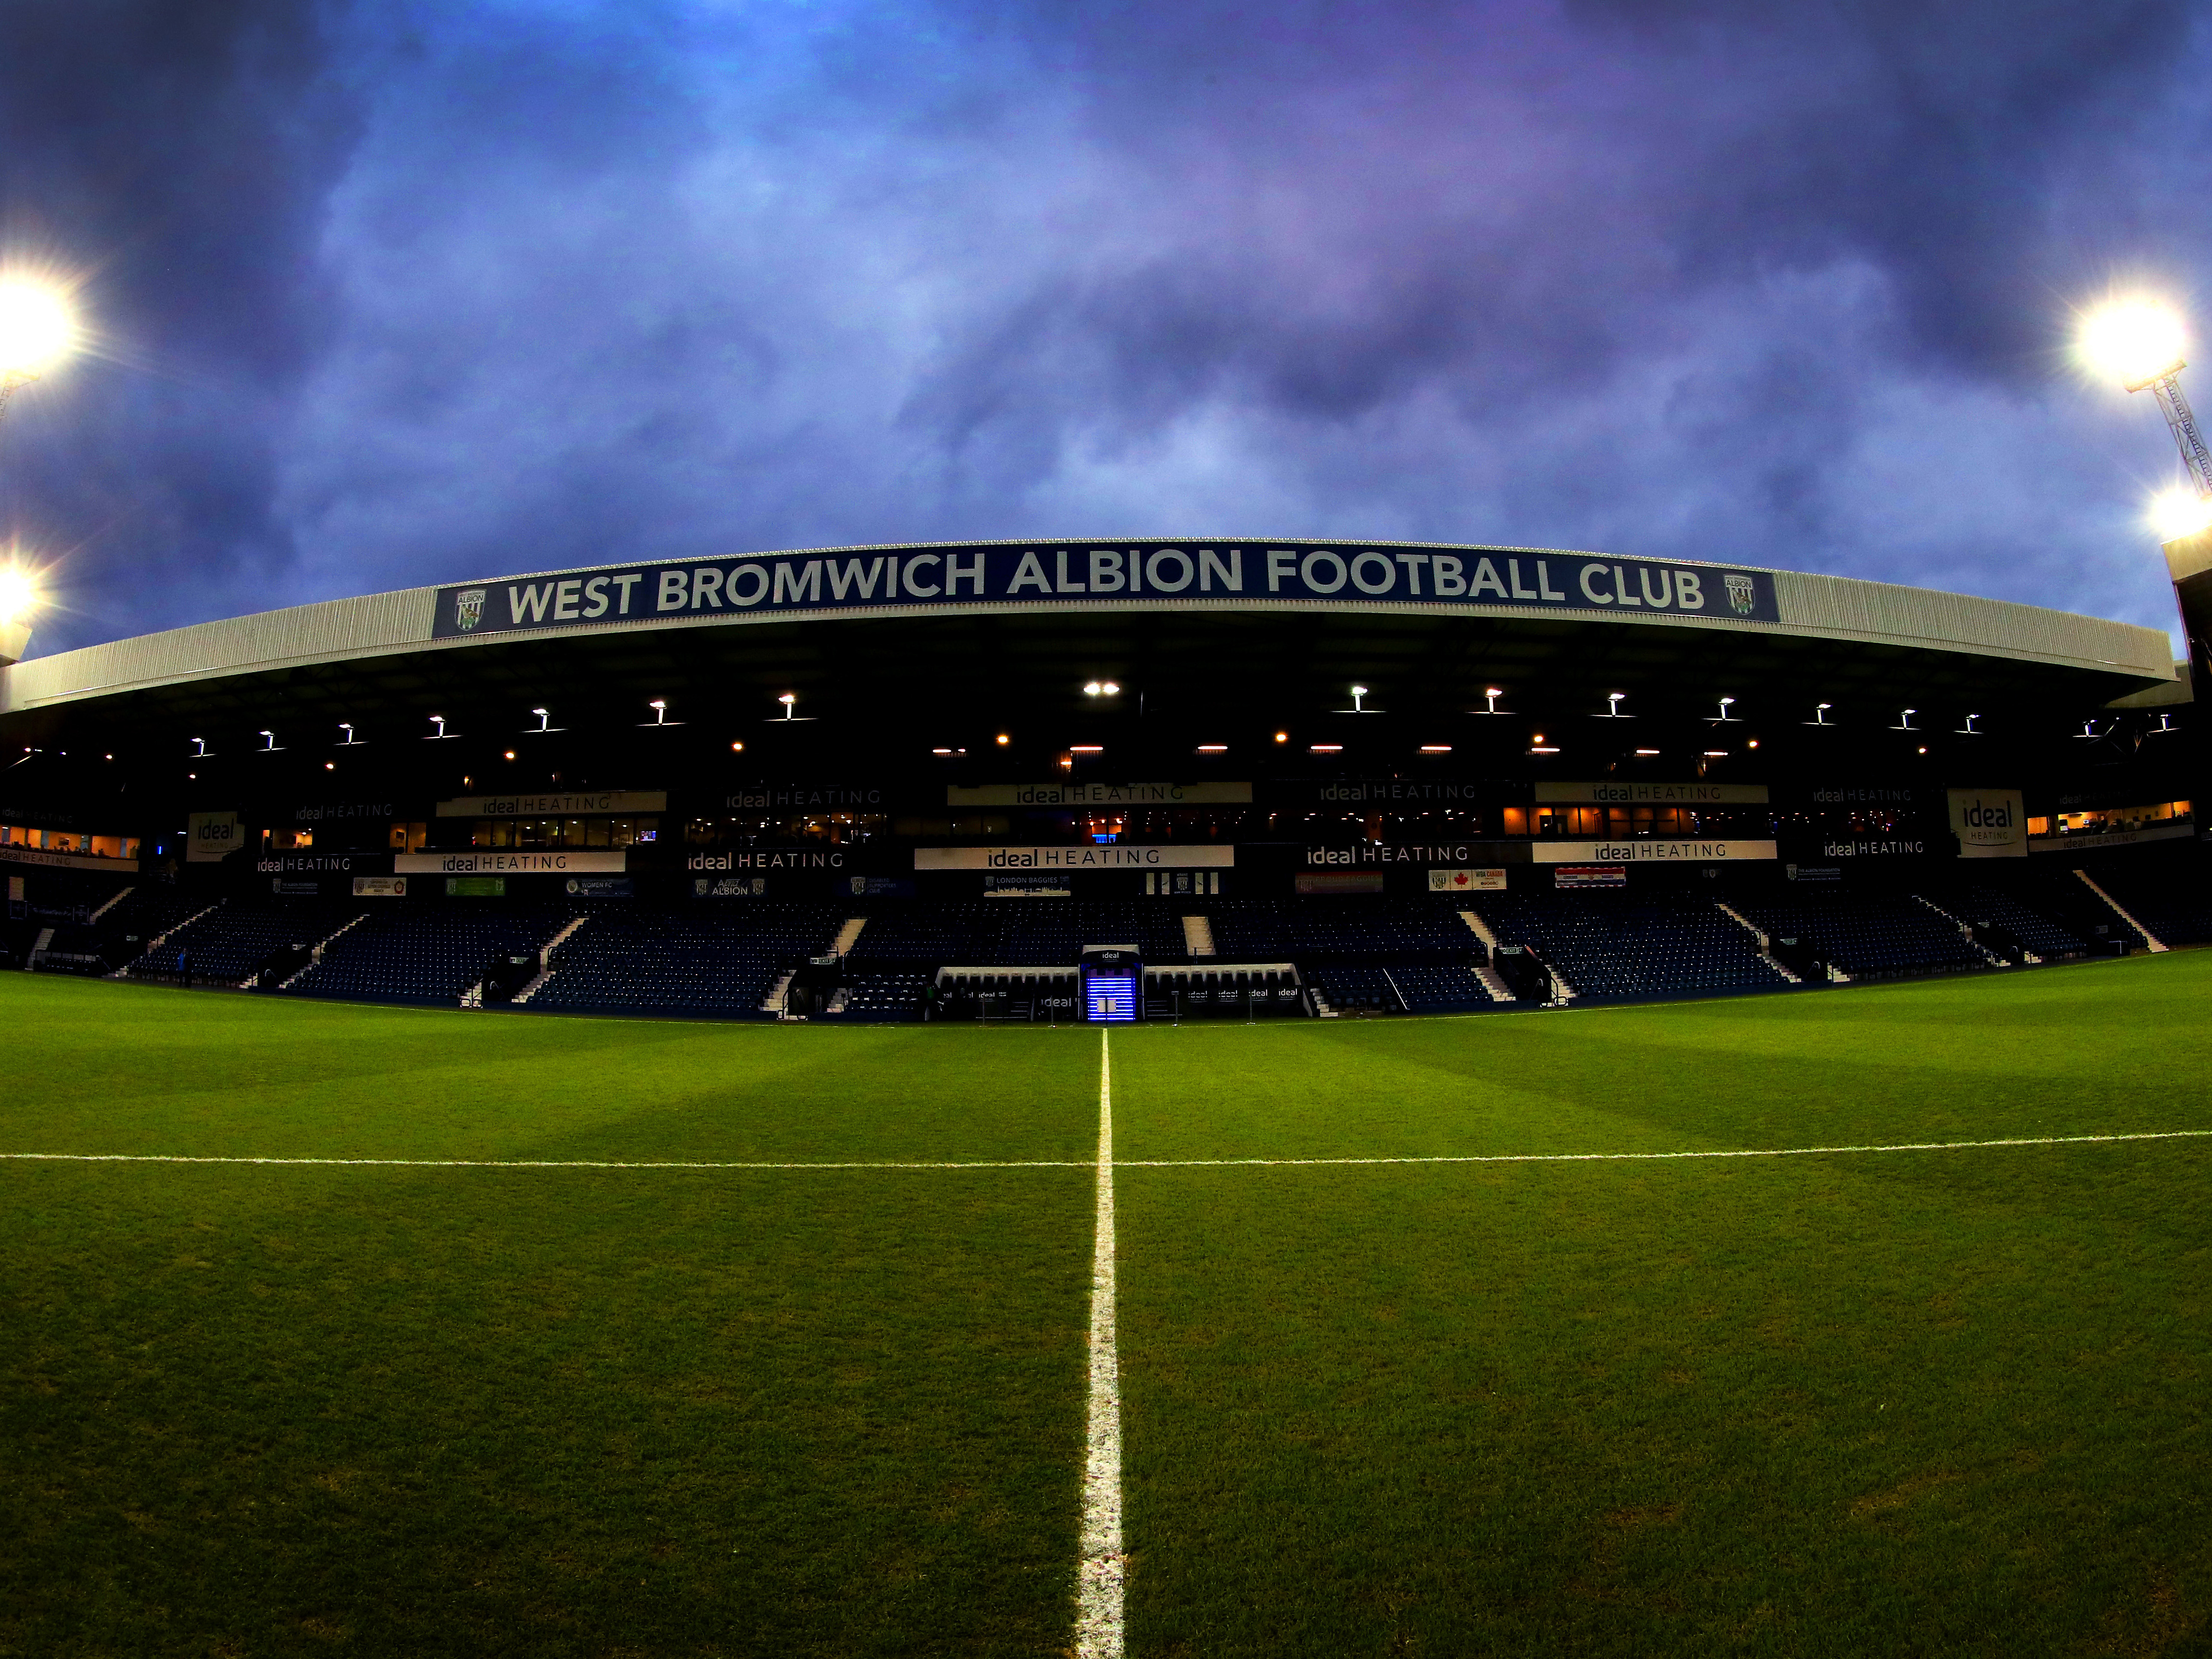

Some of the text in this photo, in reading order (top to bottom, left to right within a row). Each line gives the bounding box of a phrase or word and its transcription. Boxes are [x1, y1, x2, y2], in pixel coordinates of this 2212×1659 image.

[509, 549, 1704, 624] WEST BROMWICH ALBION FOOTBALL CLUB
[458, 595, 483, 603] ALBION
[726, 790, 881, 808] ideal HEATING
[1017, 786, 1183, 803] ideal HEATING
[1320, 783, 1475, 800] ideal HEATING
[1593, 785, 1721, 800] ideal HEATING
[1814, 788, 1911, 802] ideal HEATING
[296, 804, 392, 820] ideal HEATING
[483, 797, 611, 813] ideal HEATING
[1963, 799, 2012, 827] ideal
[197, 820, 234, 840] ideal
[1824, 841, 1923, 856] ideal HEATING
[2063, 833, 2136, 848] ideal HEATING
[23, 853, 70, 865] HEATING
[989, 849, 1159, 867] ideal HEATING
[1308, 846, 1468, 864] ideal HEATING
[1595, 843, 1726, 859] ideal HEATING
[257, 857, 350, 872] ideal HEATING
[443, 855, 567, 871] ideal HEATING
[688, 853, 843, 869] ideal HEATING
[712, 887, 748, 895] ALBION
